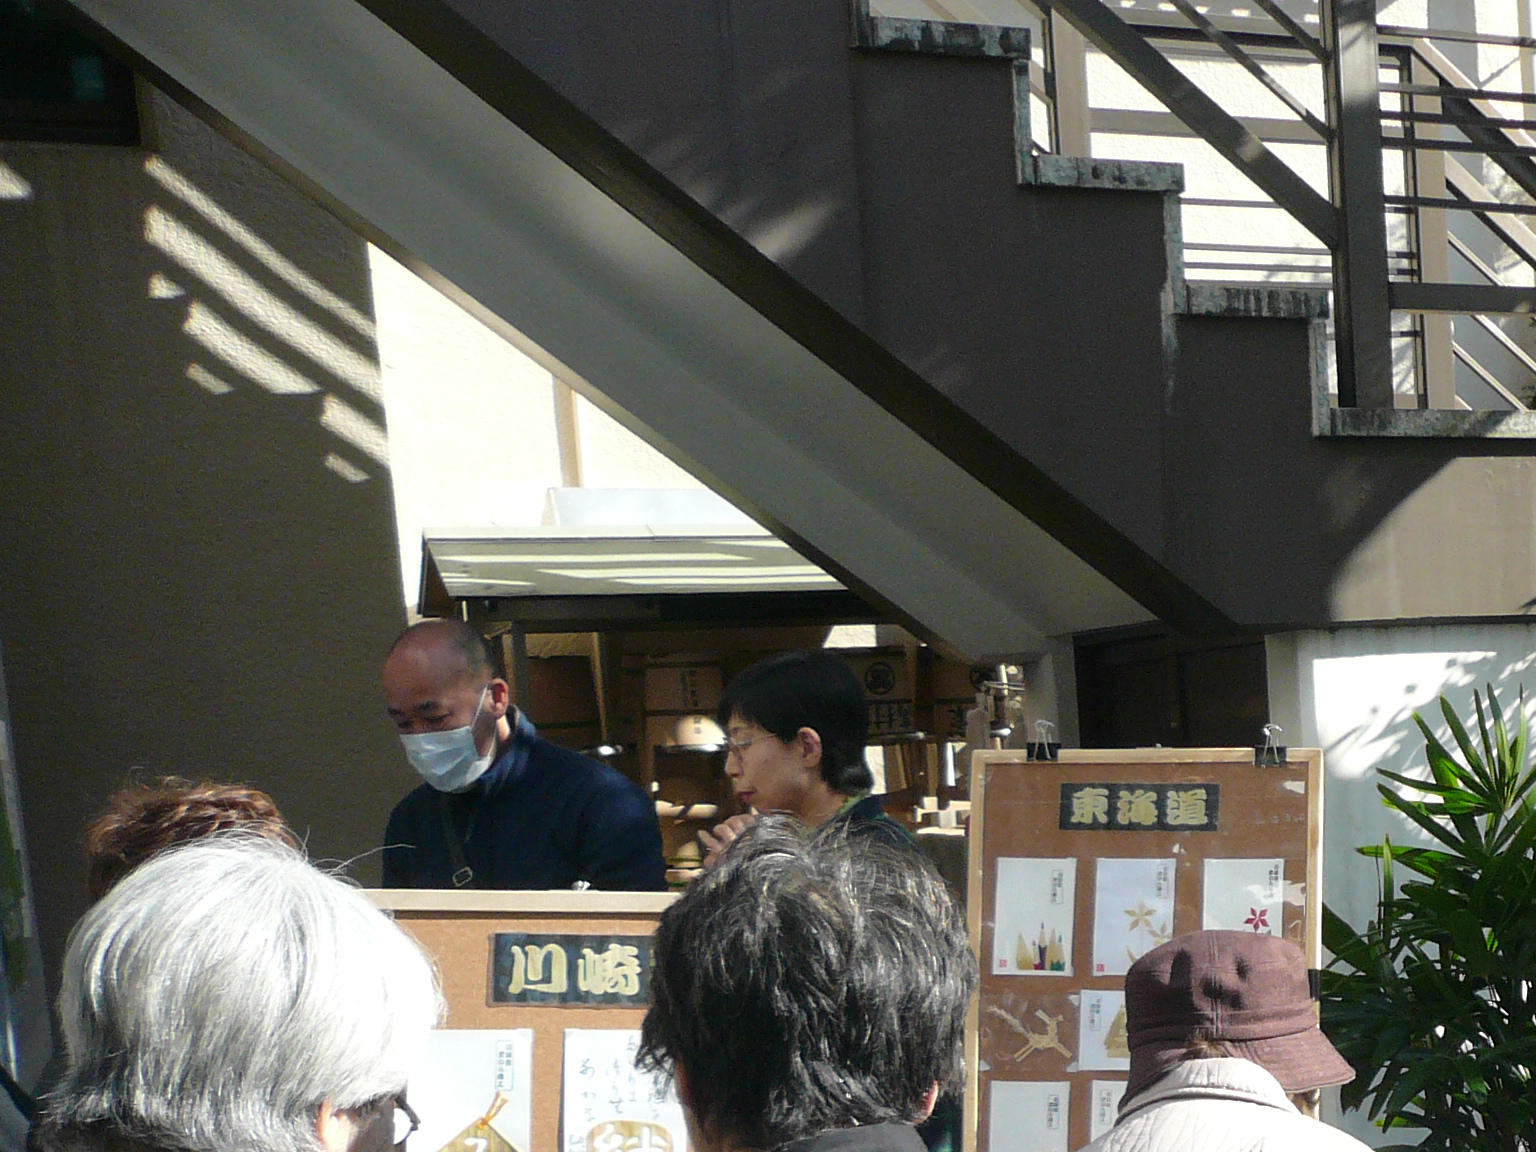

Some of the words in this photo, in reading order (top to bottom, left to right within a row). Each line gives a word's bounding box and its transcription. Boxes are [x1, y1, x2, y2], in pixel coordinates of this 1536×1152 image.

[1070, 787, 1208, 826] 東海道
[508, 943, 656, 996] 川崎
